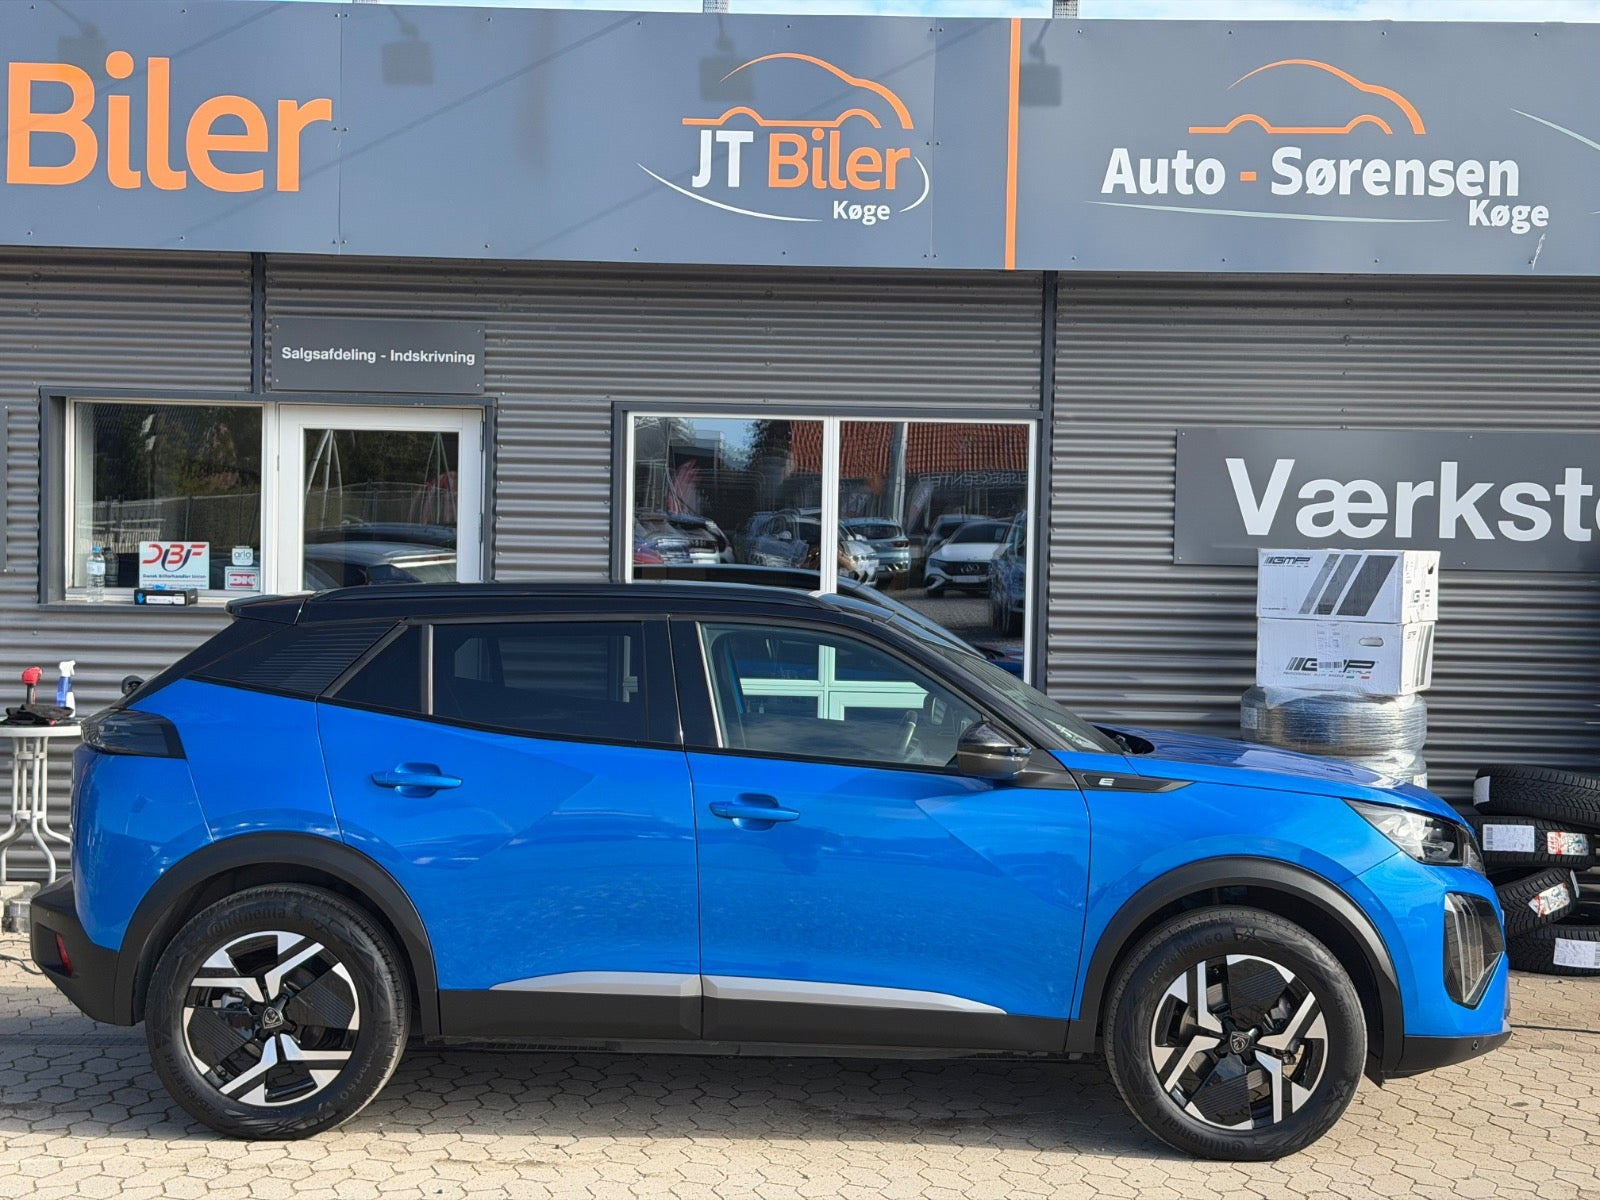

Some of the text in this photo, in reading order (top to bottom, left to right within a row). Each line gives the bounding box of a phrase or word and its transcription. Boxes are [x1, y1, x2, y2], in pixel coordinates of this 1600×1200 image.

[7, 51, 332, 193] Biler
[692, 128, 911, 191] JT Biler
[1101, 146, 1520, 198] Auto - Sørensen
[833, 200, 891, 226] Køge
[1468, 199, 1550, 235] Køge
[281, 347, 376, 364] Salgsafdeling
[390, 350, 476, 366] Indskrivning
[1225, 457, 1600, 542] Værkst
[1270, 556, 1311, 564] GMP
[1301, 658, 1376, 673] GP
